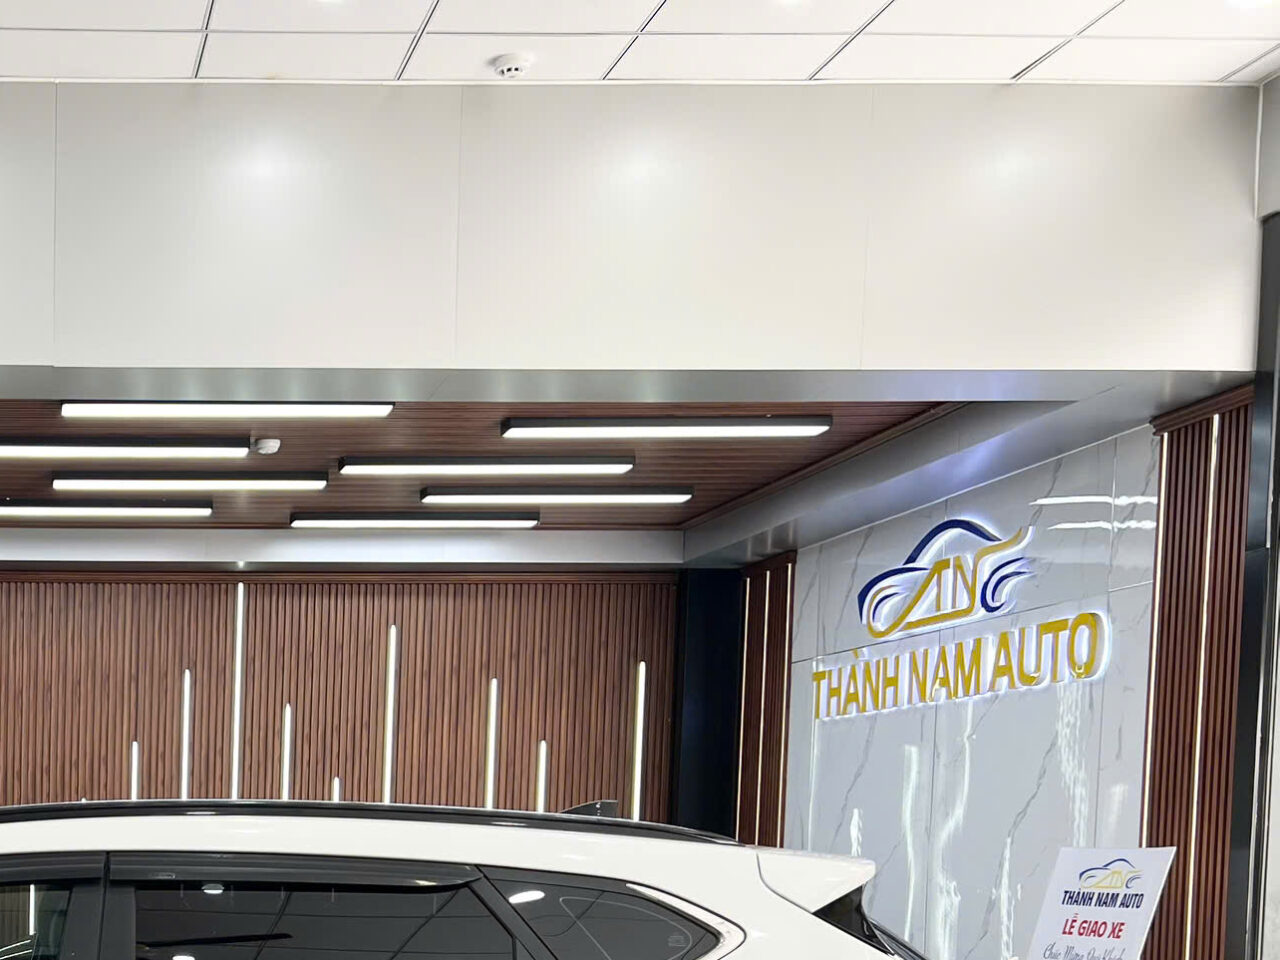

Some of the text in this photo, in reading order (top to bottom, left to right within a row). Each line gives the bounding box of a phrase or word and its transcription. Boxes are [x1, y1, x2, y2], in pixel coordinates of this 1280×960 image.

[812, 612, 1099, 719] THÀNH NAM AUTO
[1094, 892, 1120, 908] NAM
[1118, 893, 1144, 909] AUTO
[1077, 920, 1108, 938] GIAO
[1107, 921, 1126, 939] XE
